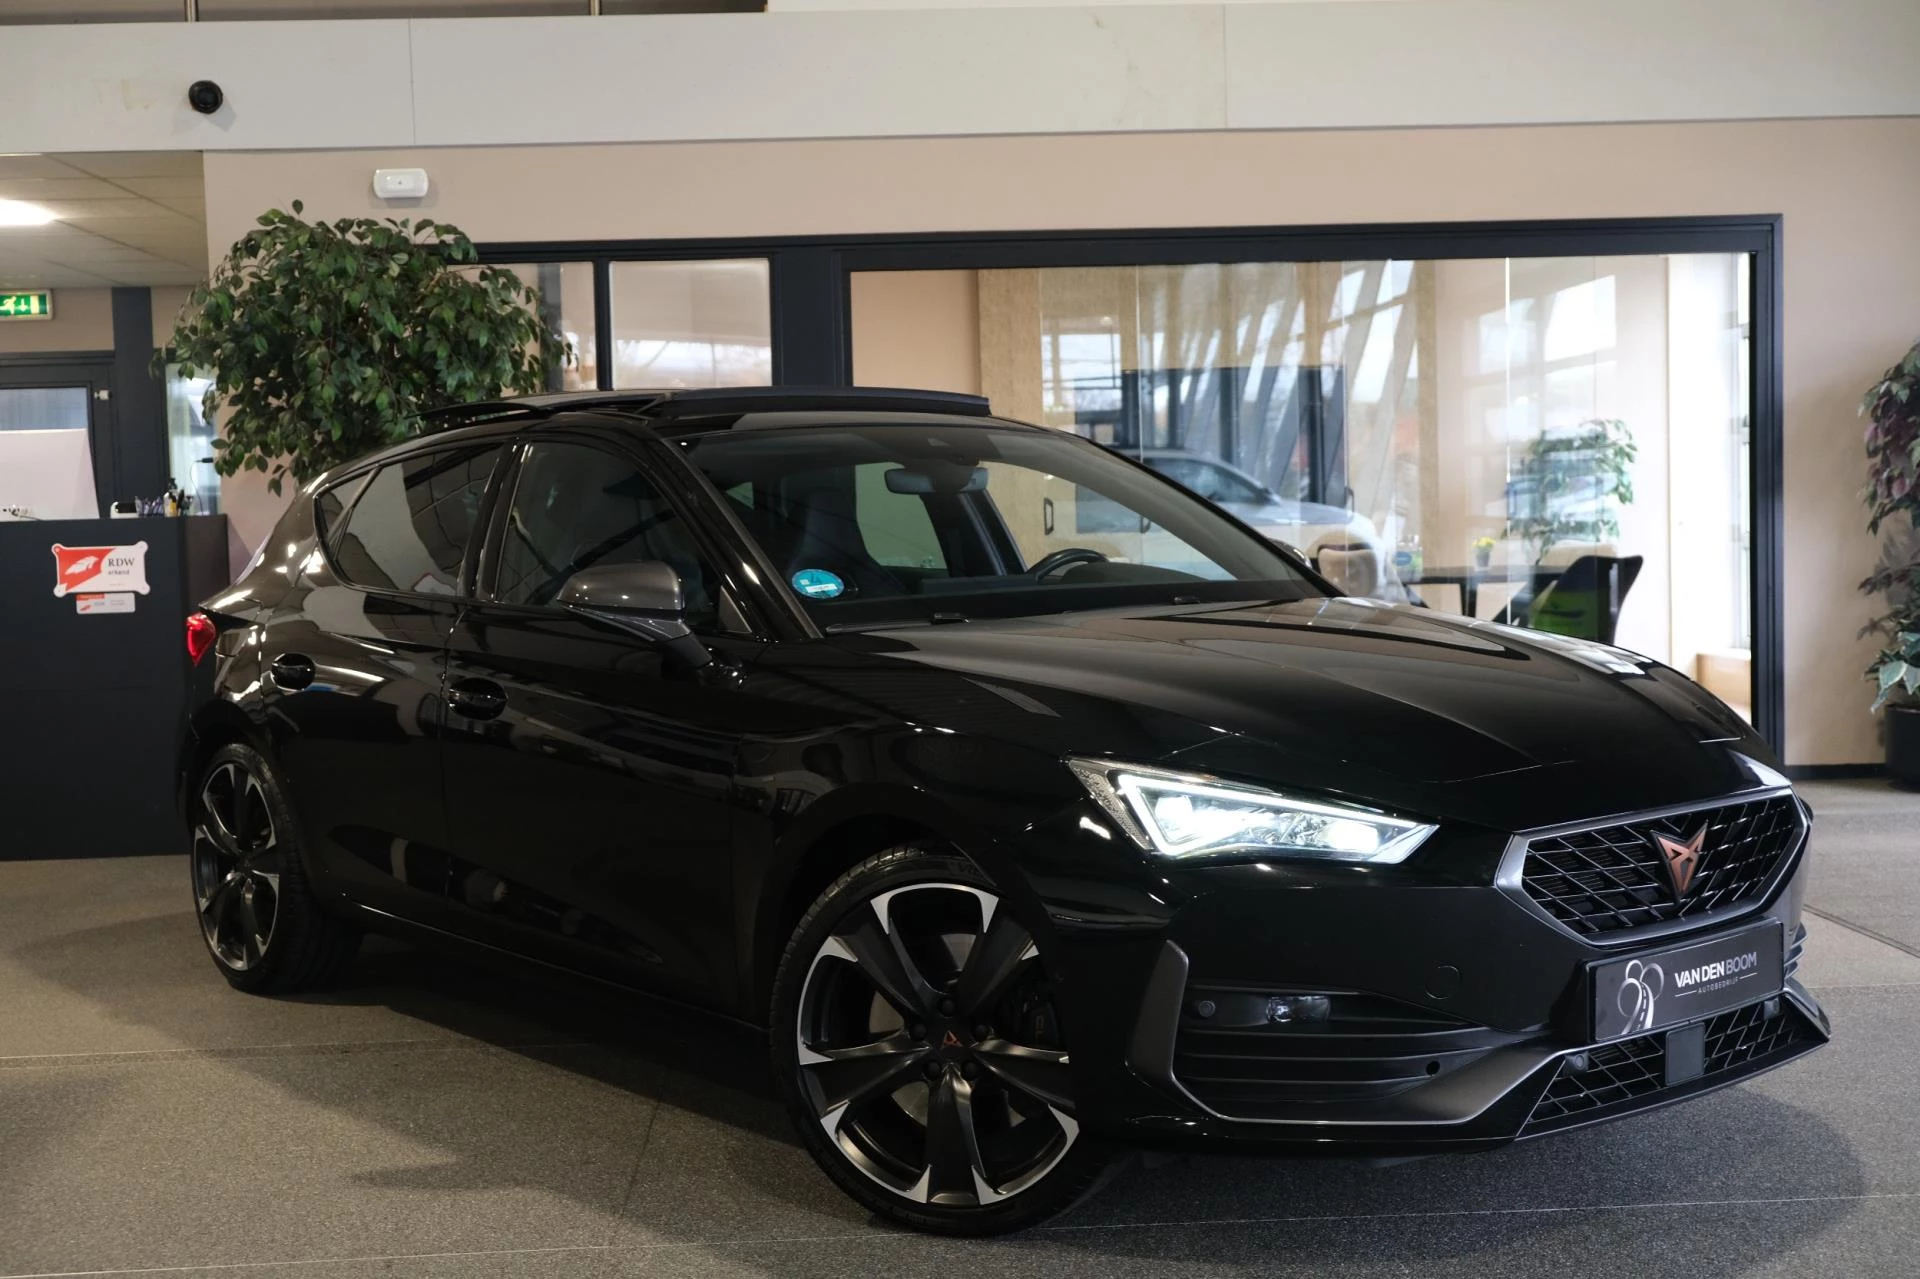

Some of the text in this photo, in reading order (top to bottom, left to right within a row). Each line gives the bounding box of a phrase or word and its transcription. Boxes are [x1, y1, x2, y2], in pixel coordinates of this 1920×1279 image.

[108, 558, 135, 567] RDW
[1674, 952, 1757, 988] VAN DEN BOOM
